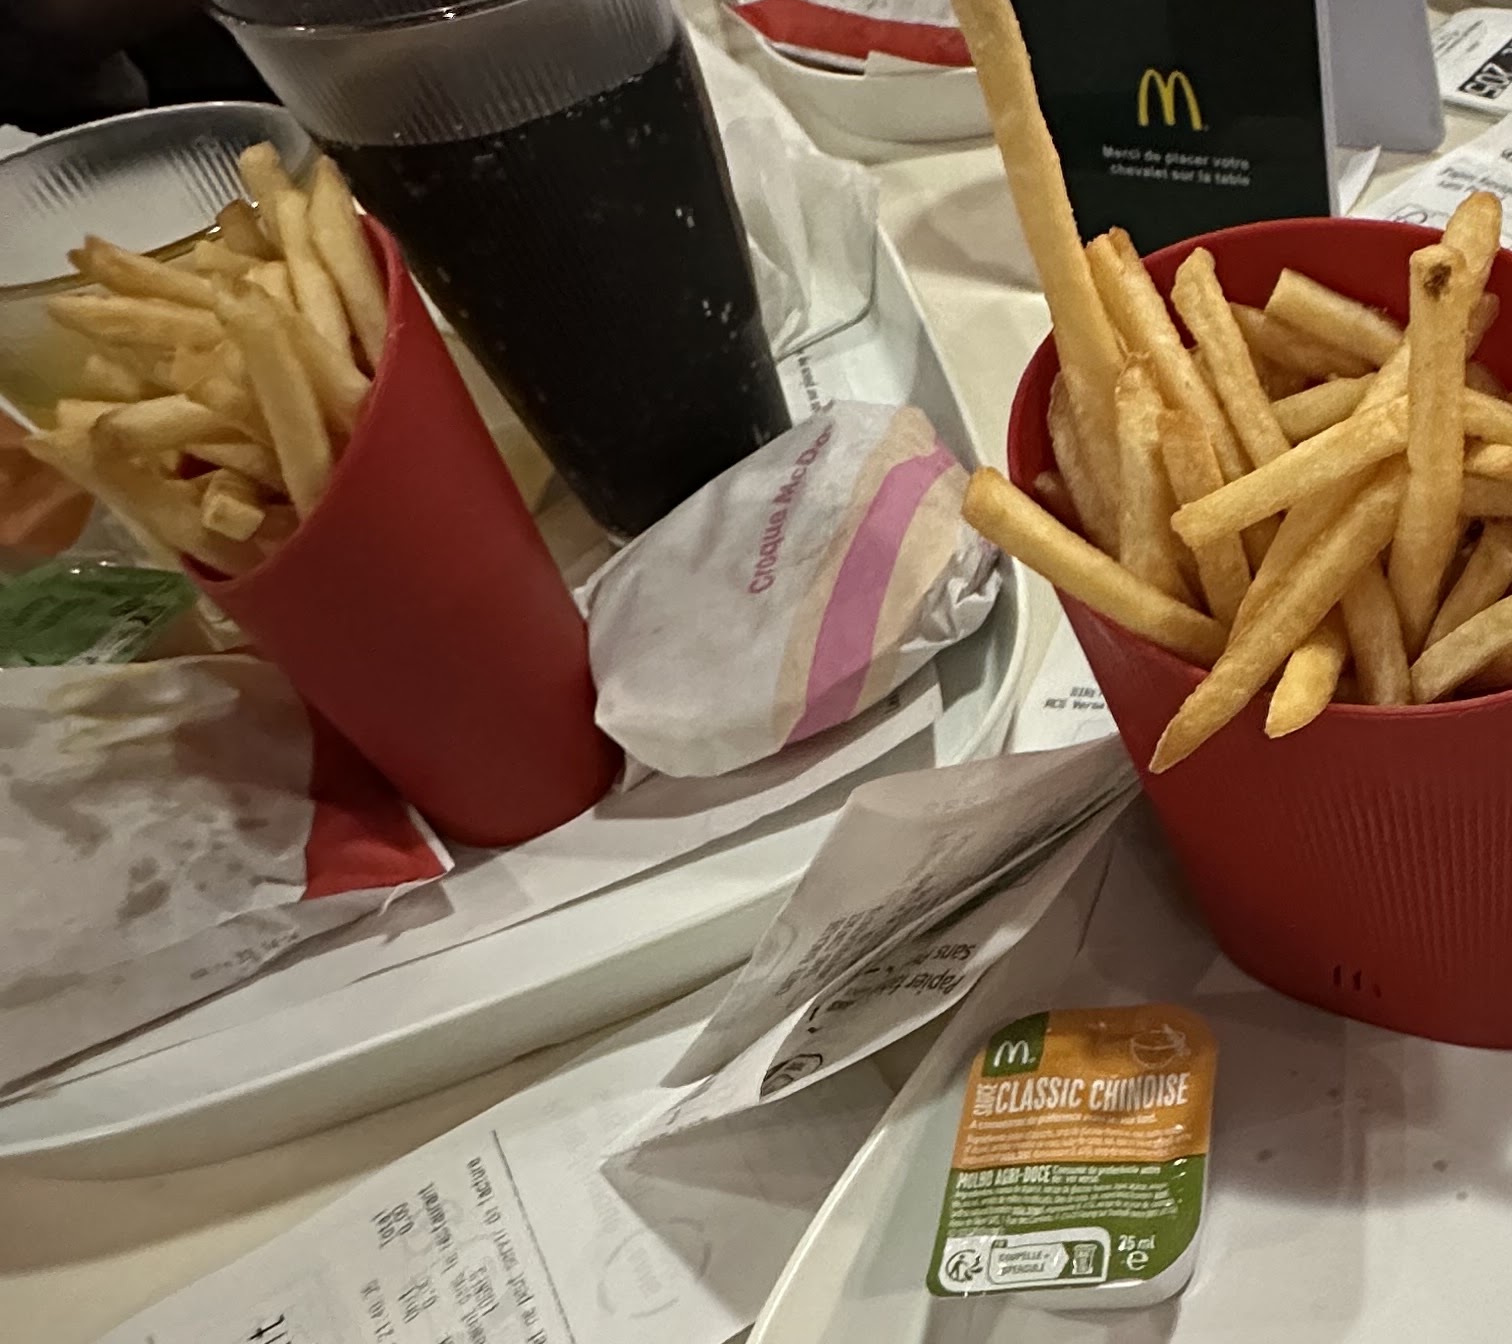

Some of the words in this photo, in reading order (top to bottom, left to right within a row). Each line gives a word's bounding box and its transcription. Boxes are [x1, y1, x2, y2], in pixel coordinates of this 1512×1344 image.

[1213, 157, 1249, 170] votre
[1214, 172, 1250, 186] table
[749, 507, 789, 595] Croque
[996, 1077, 1085, 1115] CLASSIC
[1088, 1072, 1191, 1112] CHINOISE
[467, 1157, 492, 1206] facture
[418, 1182, 451, 1250] restaurant
[1118, 1235, 1137, 1251] 25
